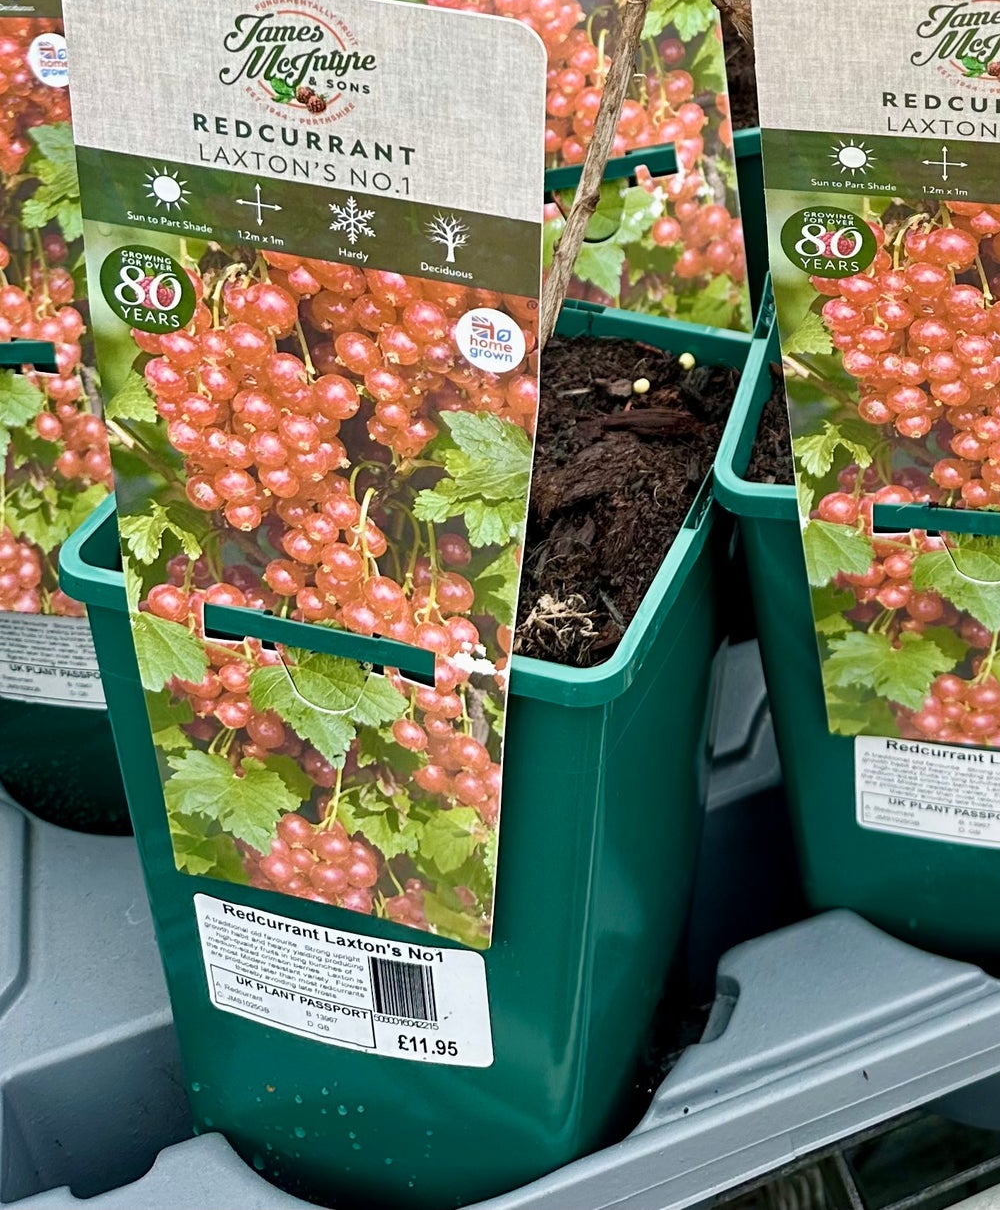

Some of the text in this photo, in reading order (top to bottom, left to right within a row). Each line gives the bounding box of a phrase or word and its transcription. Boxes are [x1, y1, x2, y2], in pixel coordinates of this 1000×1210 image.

[224, 13, 324, 53] James
[337, 20, 359, 47] FRUIT
[41, 69, 68, 77] grow
[219, 44, 377, 88] McIntyre
[309, 77, 370, 94] & SONS
[266, 104, 288, 120] 1944
[300, 102, 356, 126] PERTHSHIRE
[193, 113, 415, 165] REDCURRANT
[200, 143, 410, 195] LAXTON'S NO.1
[845, 181, 865, 189] Part
[867, 183, 897, 191] Shade
[922, 186, 944, 194] 1.2m
[955, 188, 968, 196] 1m
[127, 211, 213, 234] Sun to Part Shade
[804, 212, 854, 220] GROWING
[238, 230, 260, 241] 1.2m
[270, 236, 284, 246] 1m
[795, 224, 863, 258] 80
[121, 250, 172, 265] GROWING
[122, 257, 172, 272] FOR OVER
[338, 248, 369, 263] Hardy
[800, 257, 859, 272] YEARS
[420, 262, 473, 280] Deciduous
[114, 265, 182, 311] 80
[120, 305, 180, 328] YEARS
[470, 335, 513, 353] home
[469, 347, 513, 362] grown
[26, 666, 58, 676] PLANT
[61, 670, 101, 679] PASSPO
[886, 740, 984, 763] Redcurrant
[888, 797, 905, 806] UK
[910, 802, 950, 814] PLANT
[222, 903, 444, 963] Redcurrant Laxton's No1
[325, 958, 364, 971] producing
[333, 953, 360, 962] upright
[236, 976, 369, 1019] UK PLANT PASSPORT
[398, 1035, 458, 1056] £11.95
